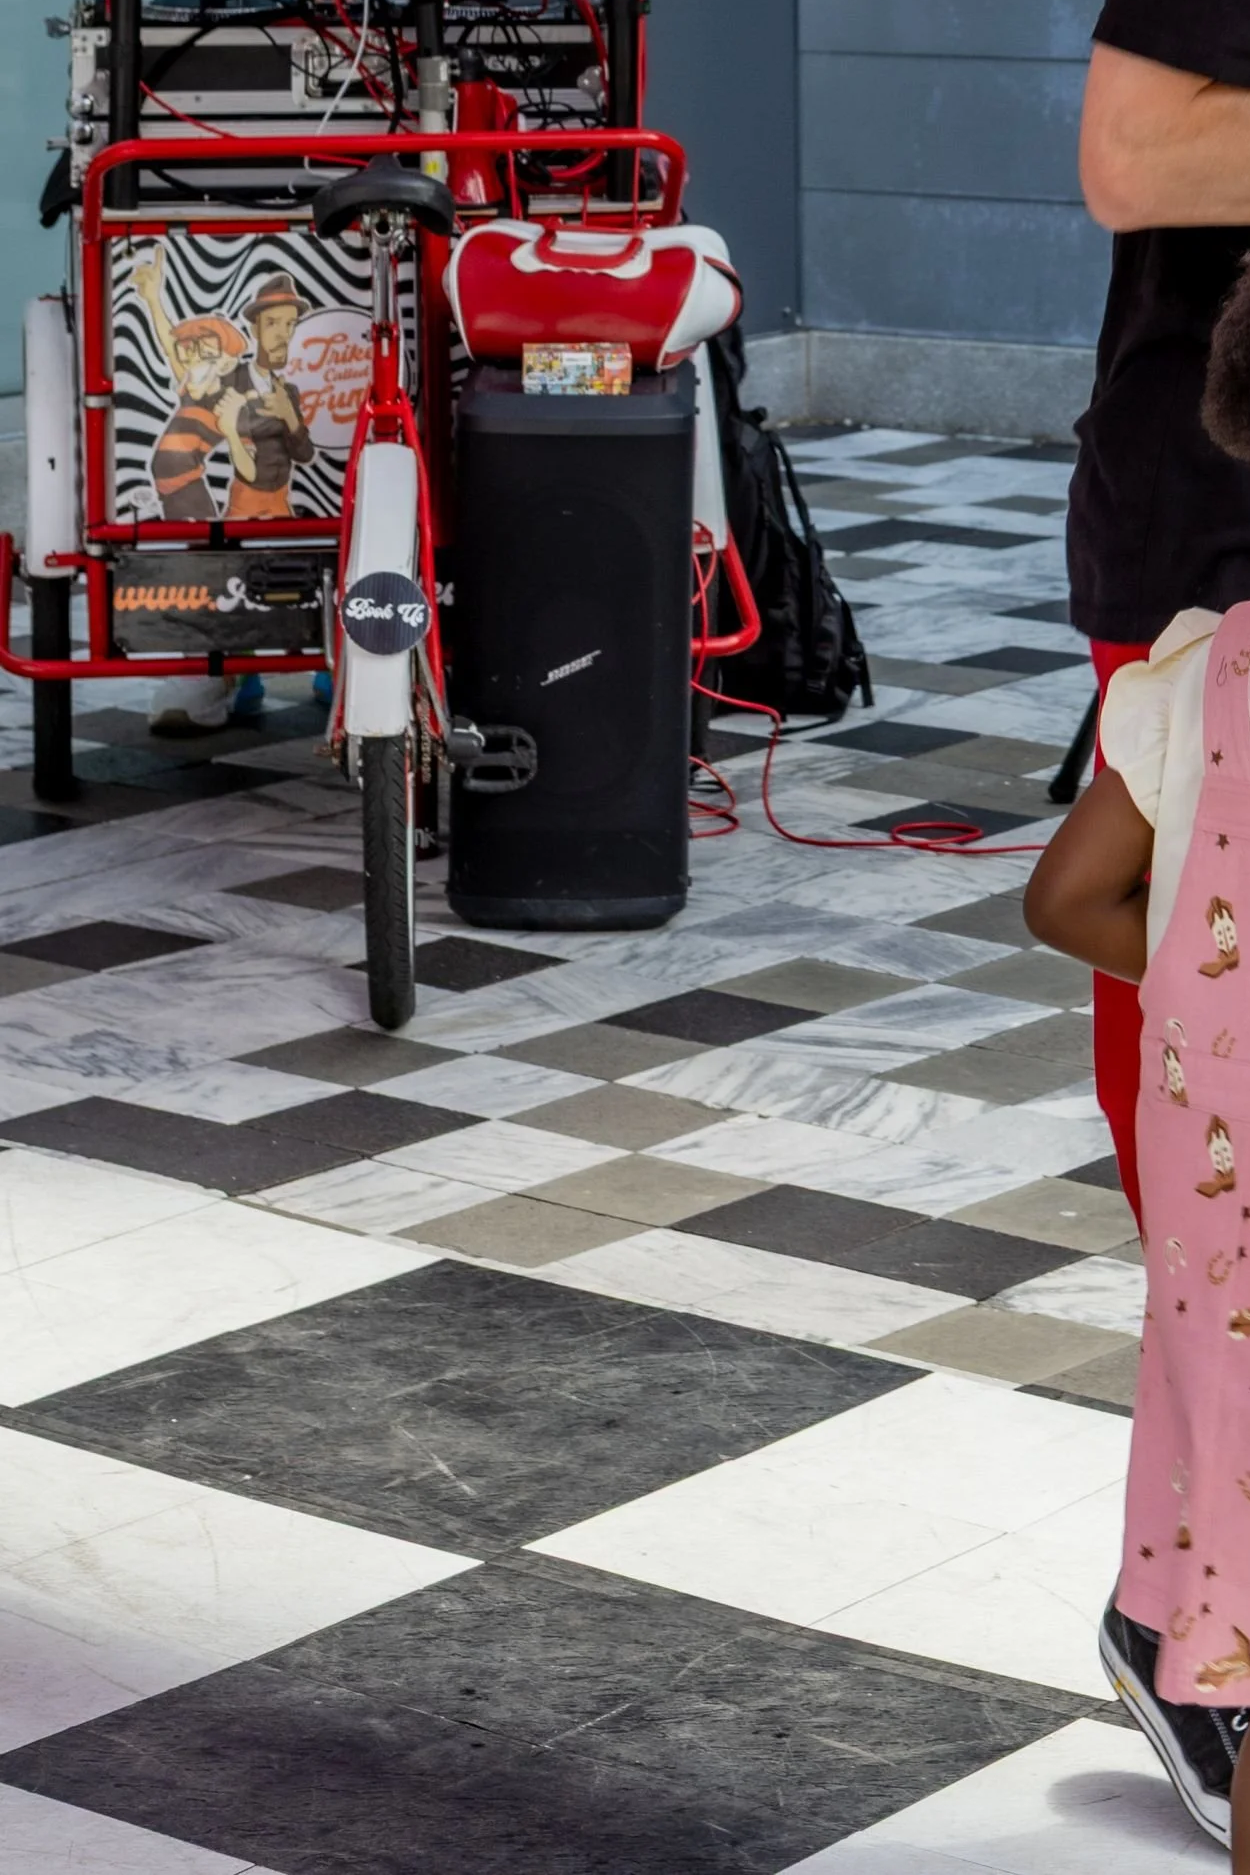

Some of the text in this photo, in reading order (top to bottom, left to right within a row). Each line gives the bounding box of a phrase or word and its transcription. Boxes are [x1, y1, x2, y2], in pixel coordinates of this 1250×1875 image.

[322, 366, 370, 383] Called
[345, 597, 425, 627] Book Us
